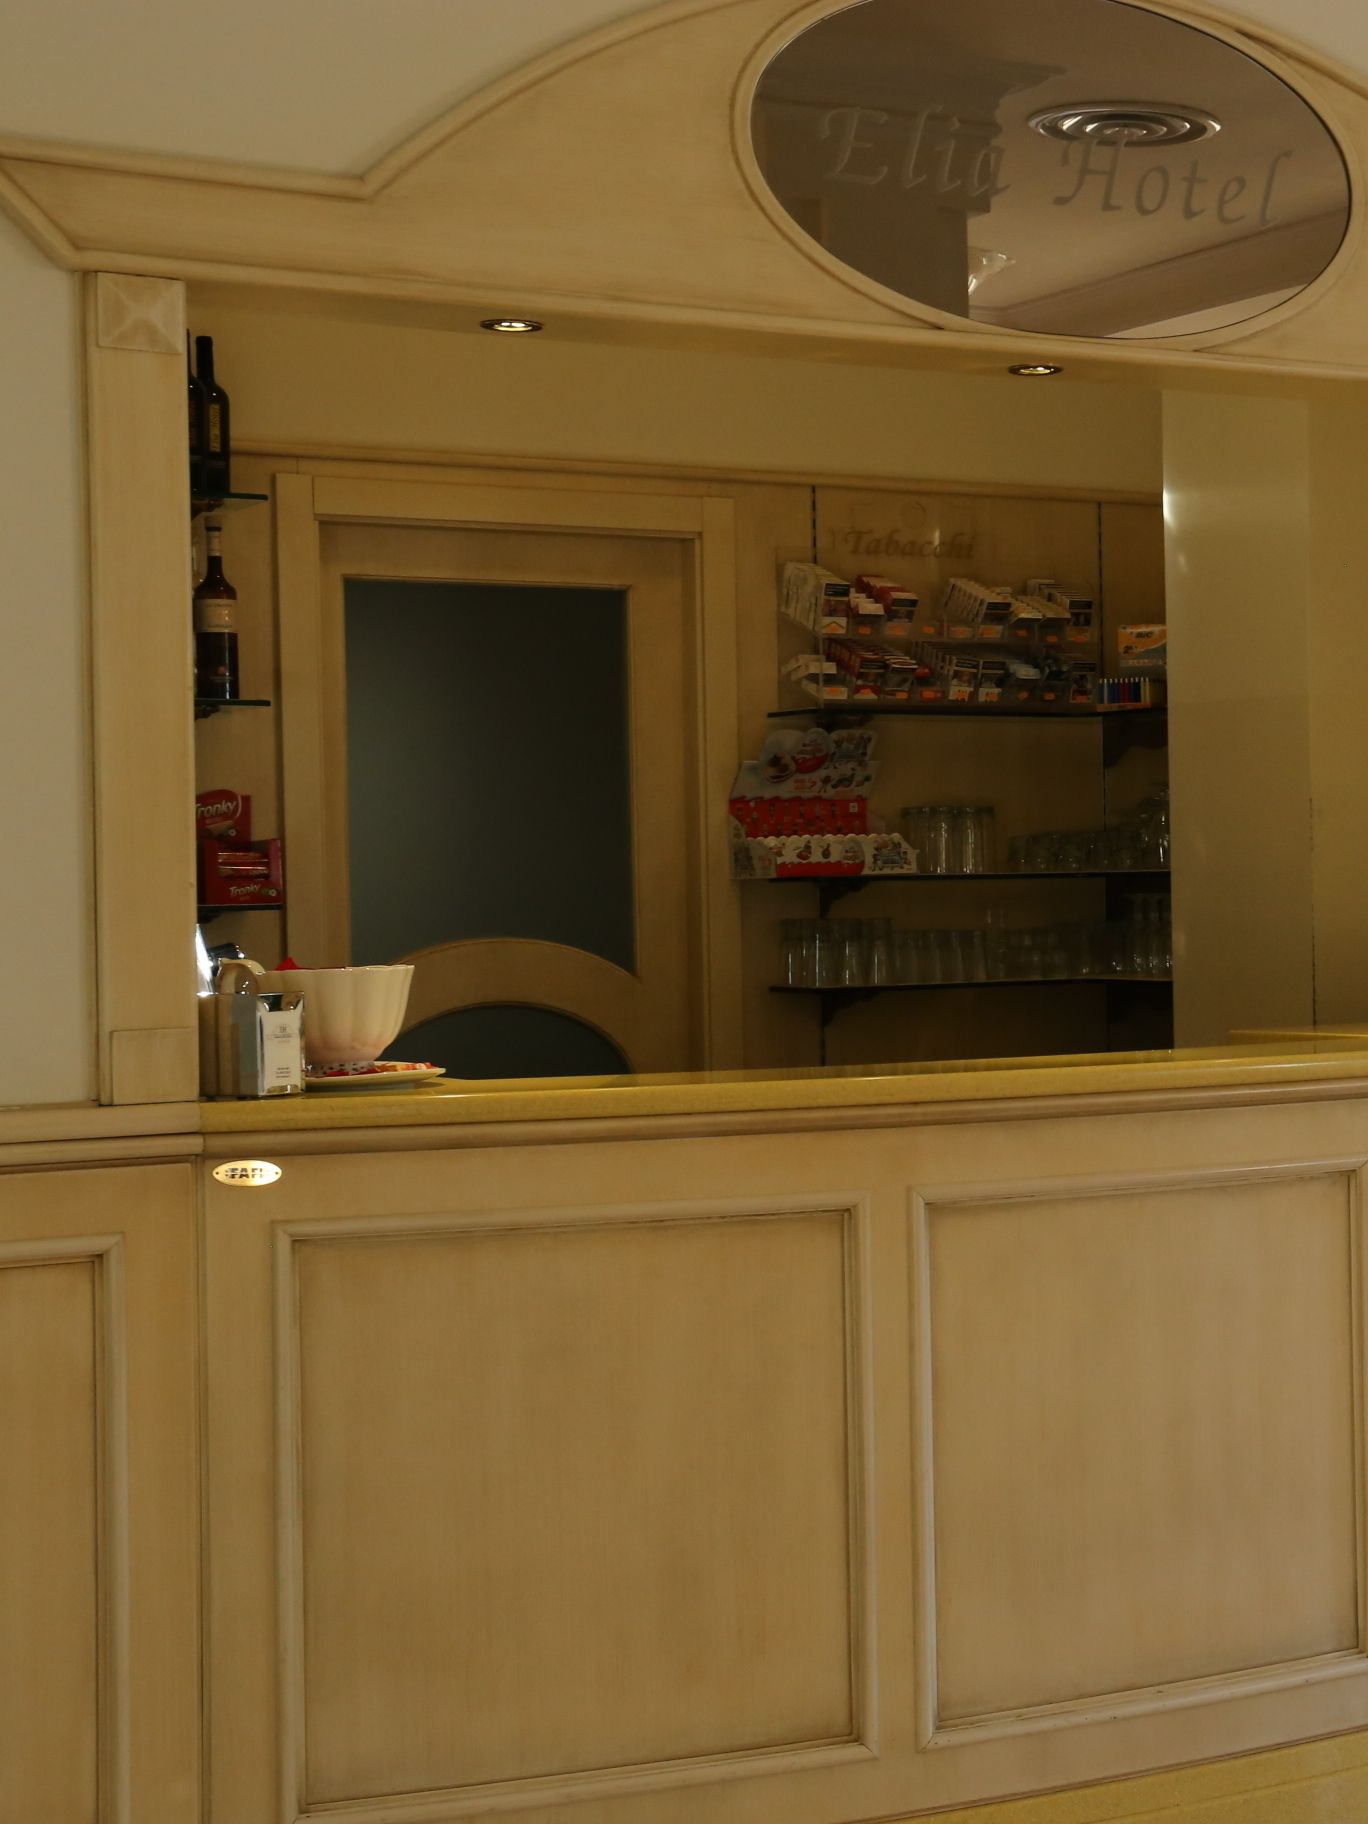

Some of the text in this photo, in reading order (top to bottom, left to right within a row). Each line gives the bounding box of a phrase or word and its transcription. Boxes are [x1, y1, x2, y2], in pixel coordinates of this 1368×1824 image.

[819, 104, 1294, 228] Elia Hotel
[844, 529, 976, 560] Tabacchi
